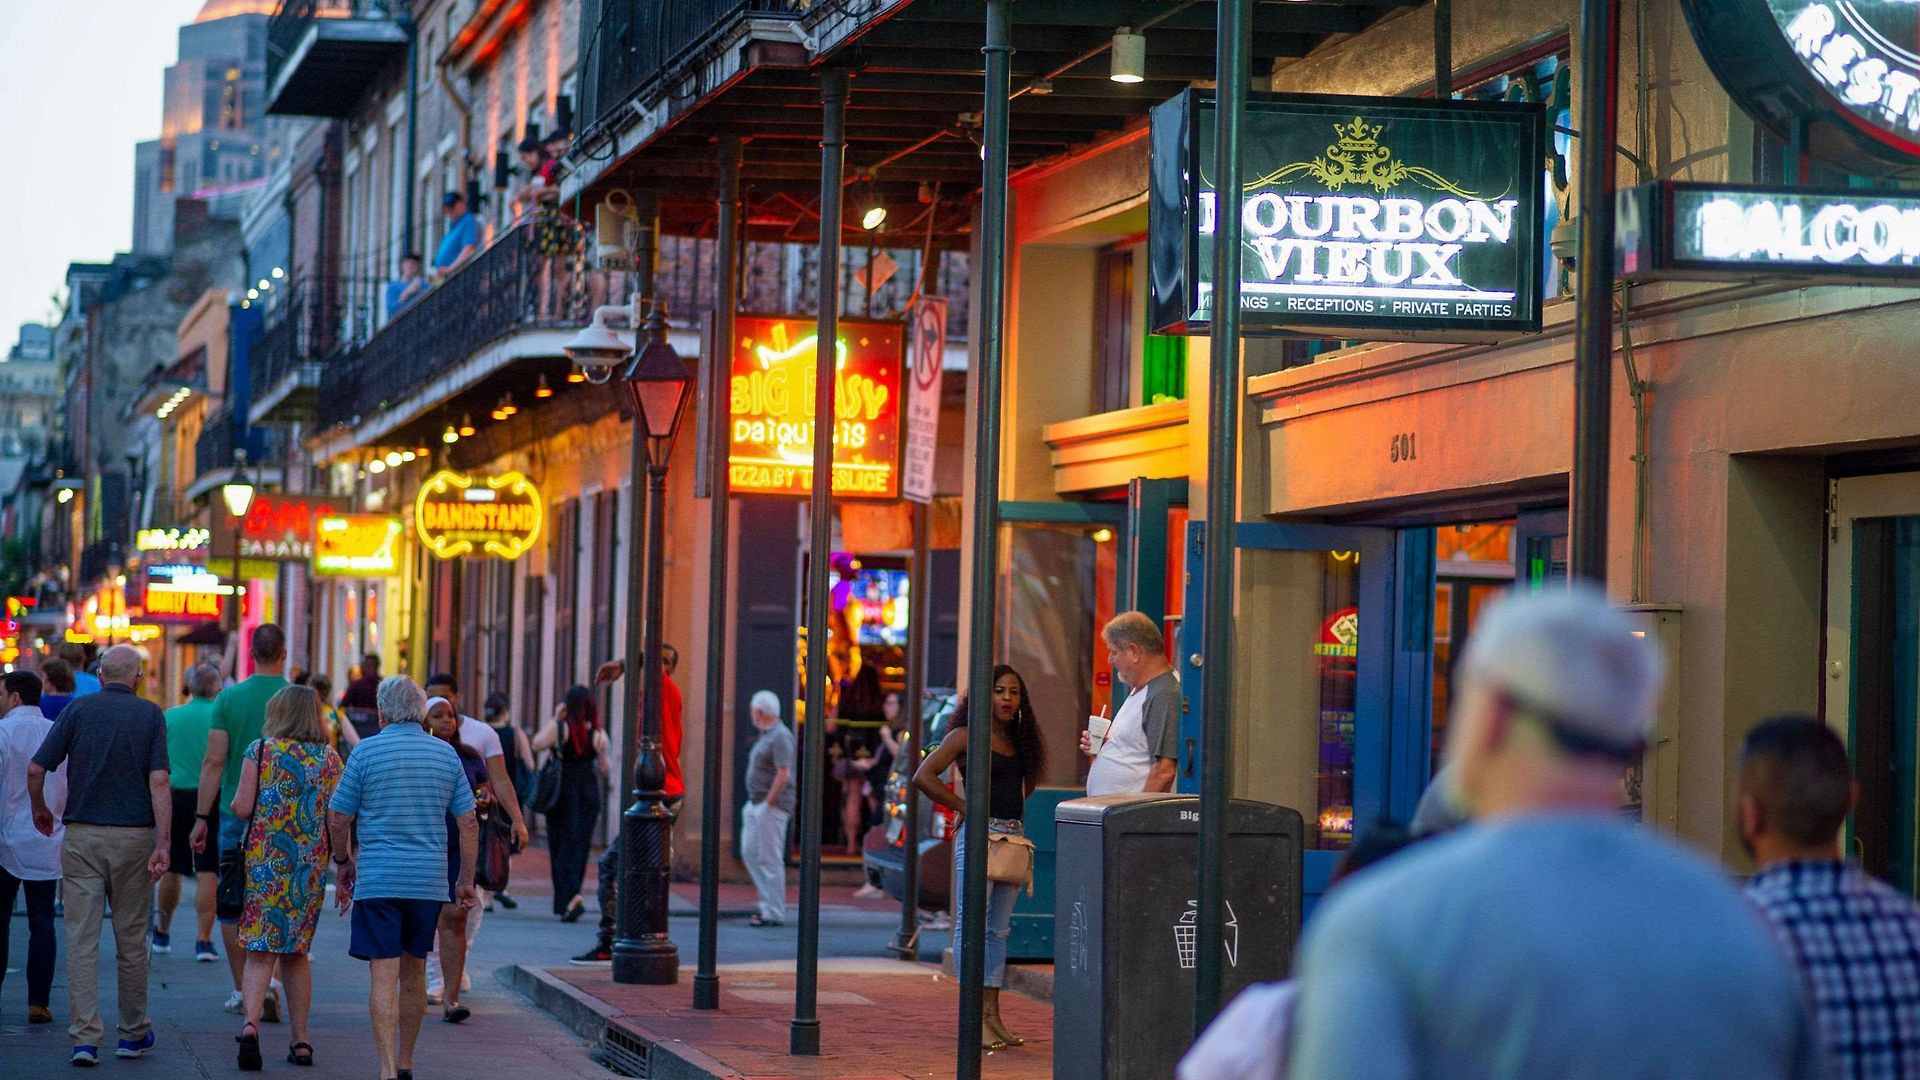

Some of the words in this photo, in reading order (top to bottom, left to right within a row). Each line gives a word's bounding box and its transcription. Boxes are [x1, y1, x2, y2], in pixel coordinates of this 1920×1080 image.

[1251, 236, 1463, 286] VIEUX
[1287, 297, 1374, 313] RECEPTIONS
[1393, 301, 1449, 315] PRIVATE
[1455, 303, 1512, 317] PARTIES
[731, 368, 789, 416] BIG
[729, 465, 771, 487] IZZA
[773, 468, 796, 488] BY
[424, 502, 534, 531] BANDSTAND
